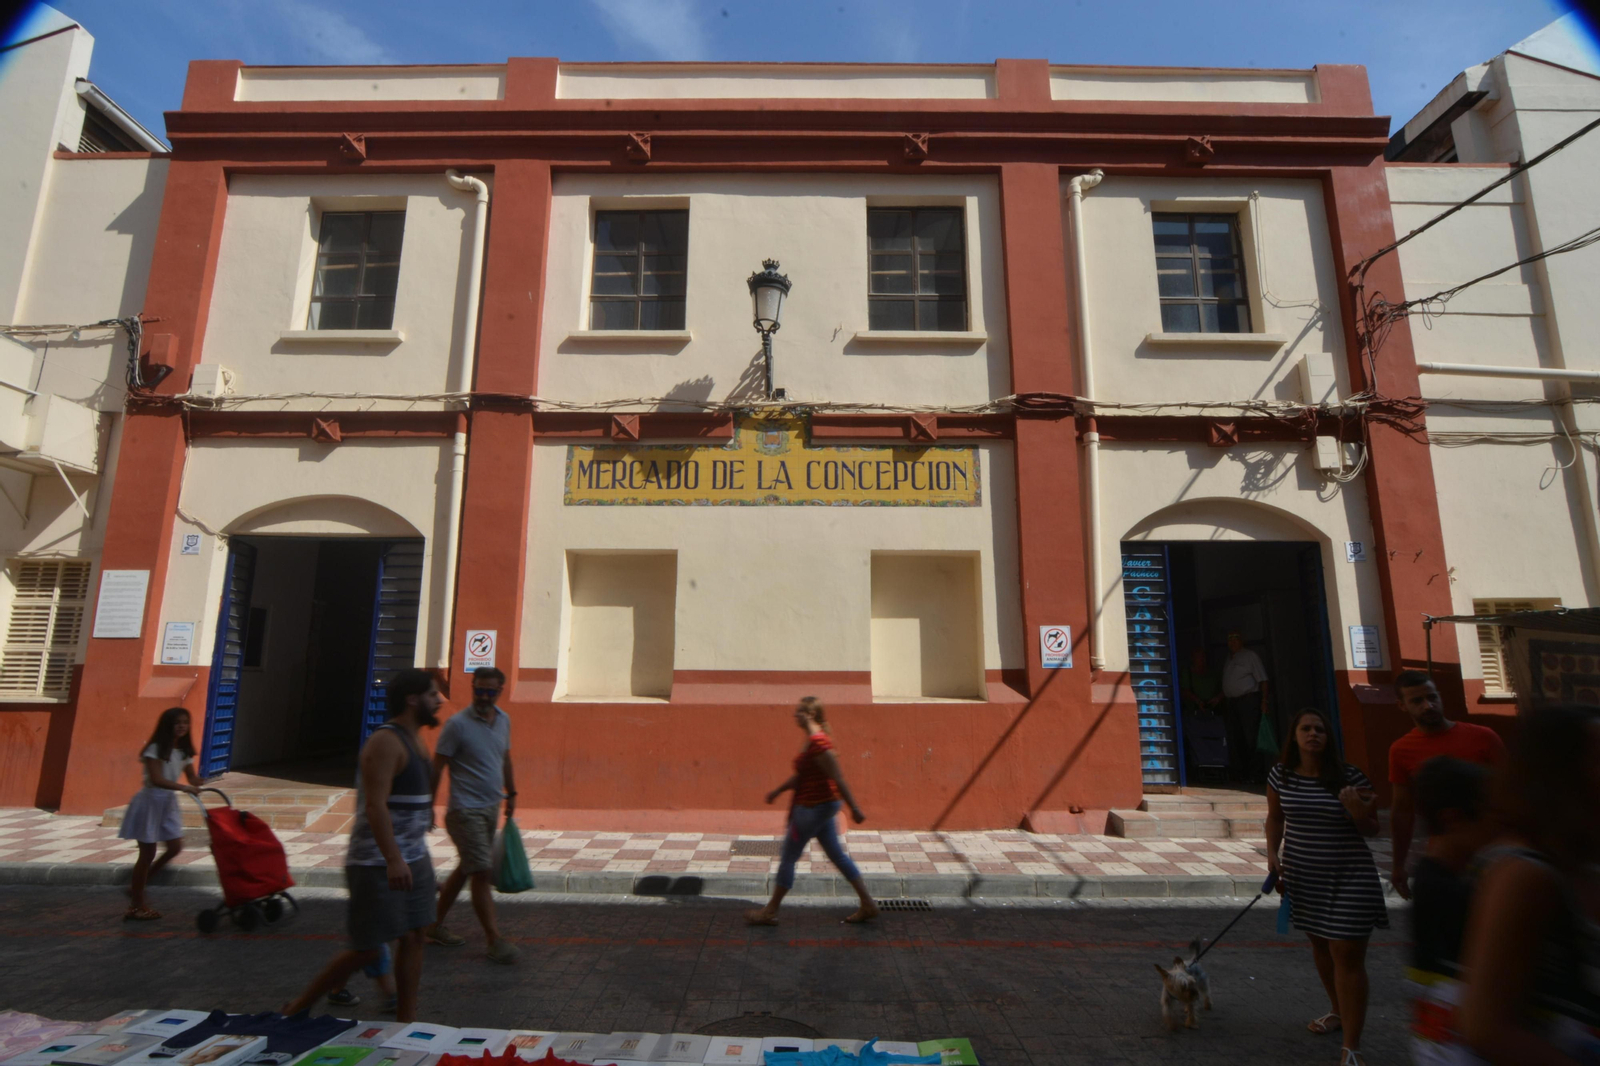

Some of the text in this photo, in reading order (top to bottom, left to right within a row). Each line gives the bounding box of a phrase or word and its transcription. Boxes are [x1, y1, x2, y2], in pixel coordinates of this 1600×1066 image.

[577, 459, 970, 491] MERCADO DE LA CONCEPCION
